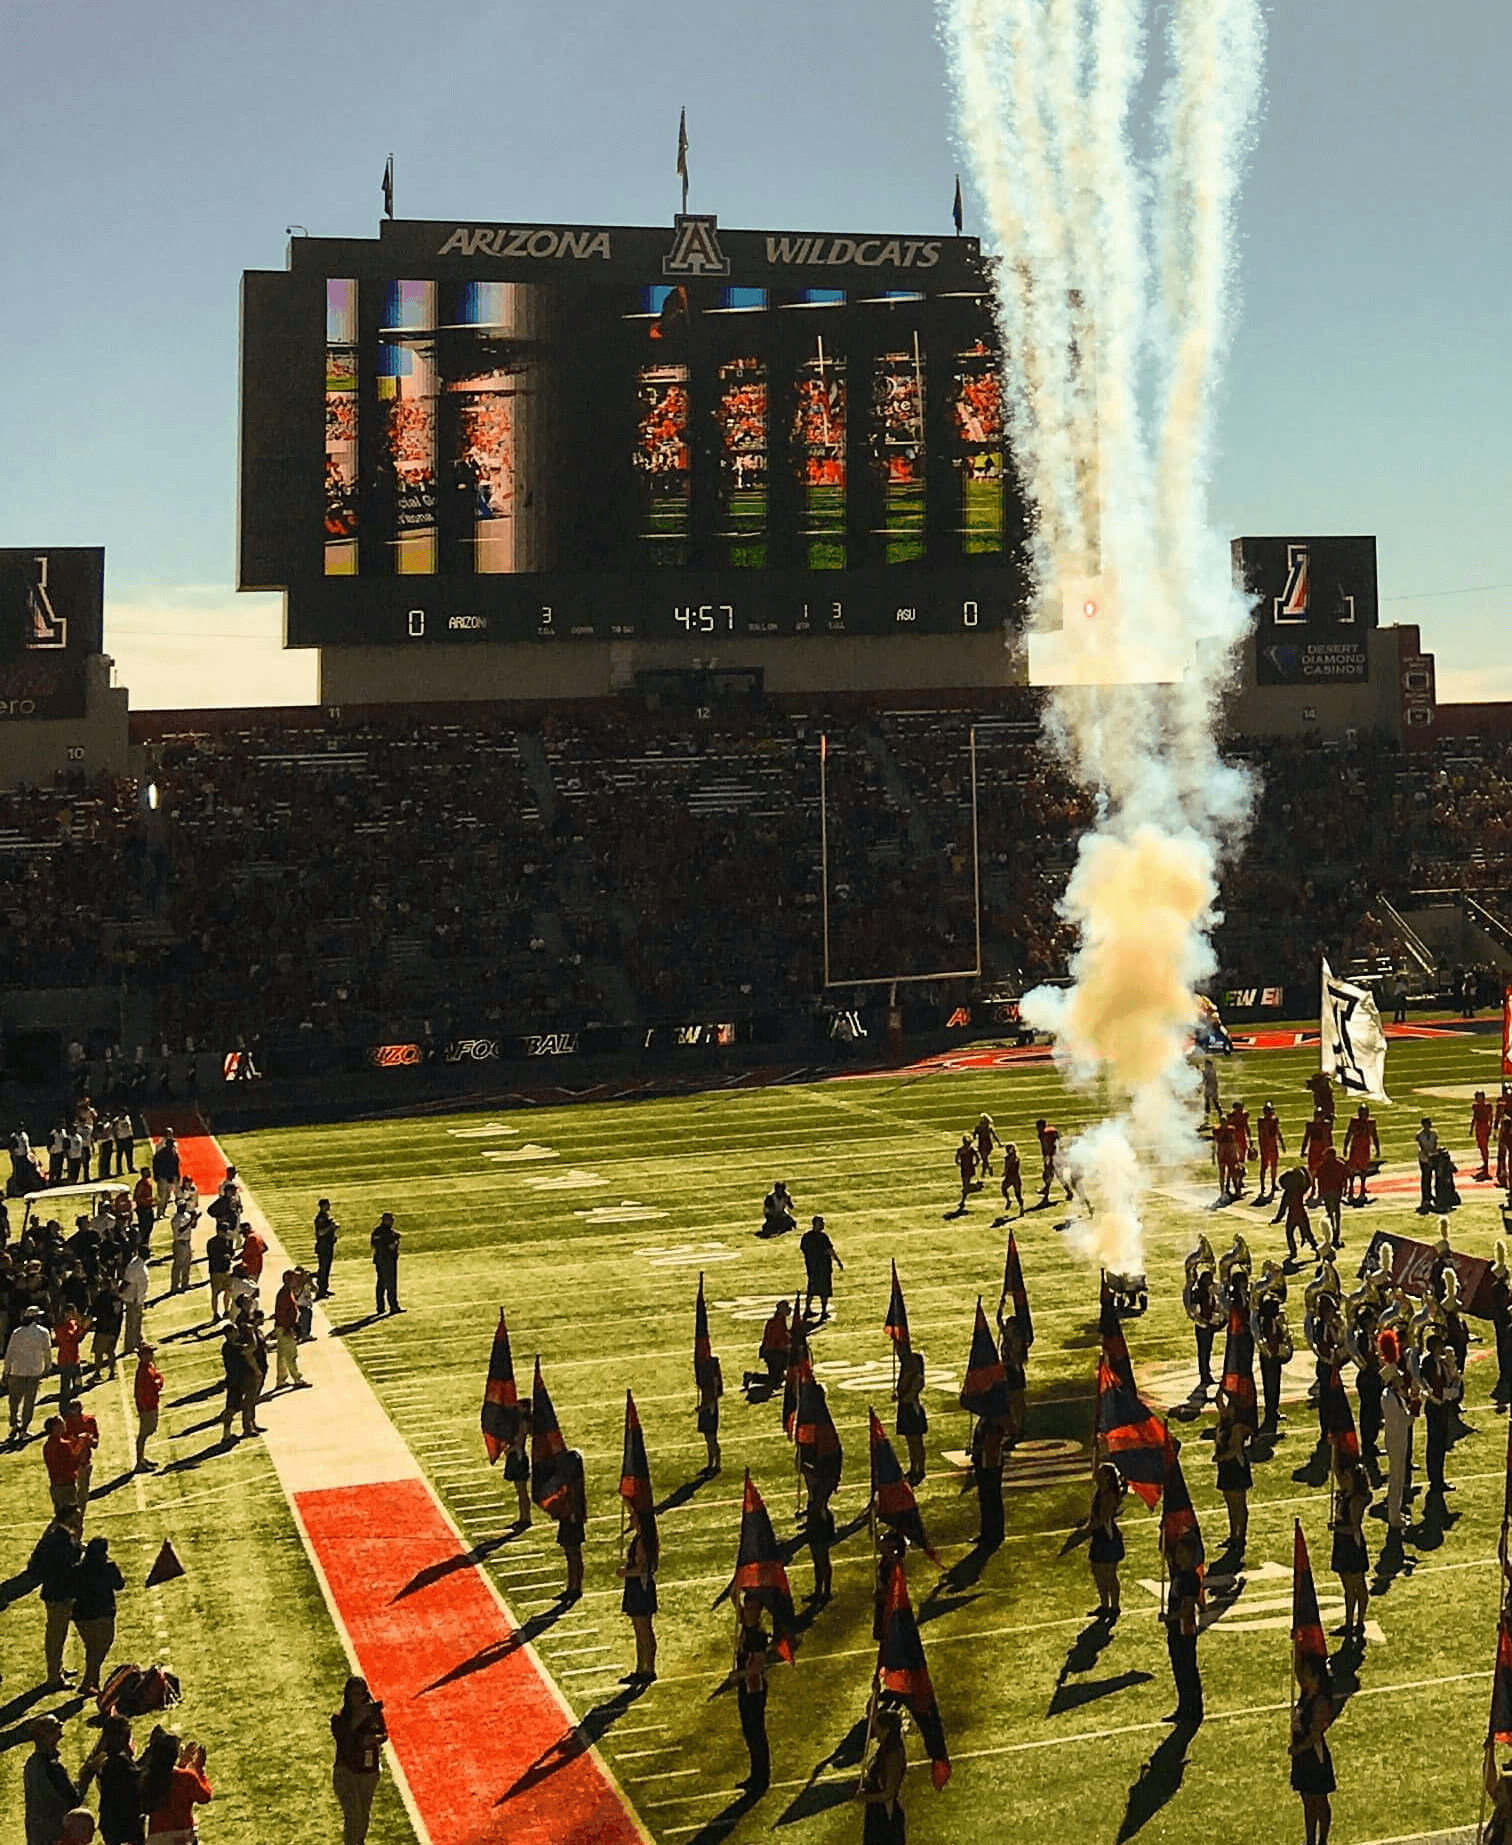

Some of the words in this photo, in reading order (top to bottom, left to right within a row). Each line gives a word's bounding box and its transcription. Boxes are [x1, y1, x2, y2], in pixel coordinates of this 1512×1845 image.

[438, 228, 611, 259] ARIZONA
[664, 216, 728, 275] A
[766, 236, 942, 267] WILDCATS
[542, 607, 552, 623] 3
[674, 605, 733, 631] 4:57
[832, 602, 842, 619] 3
[963, 601, 978, 626] 0
[408, 610, 424, 636] 0
[1307, 644, 1359, 655] DESERT
[1302, 655, 1366, 665] DIAMOND
[1303, 665, 1364, 675] CASINOS
[67, 747, 84, 760] 10
